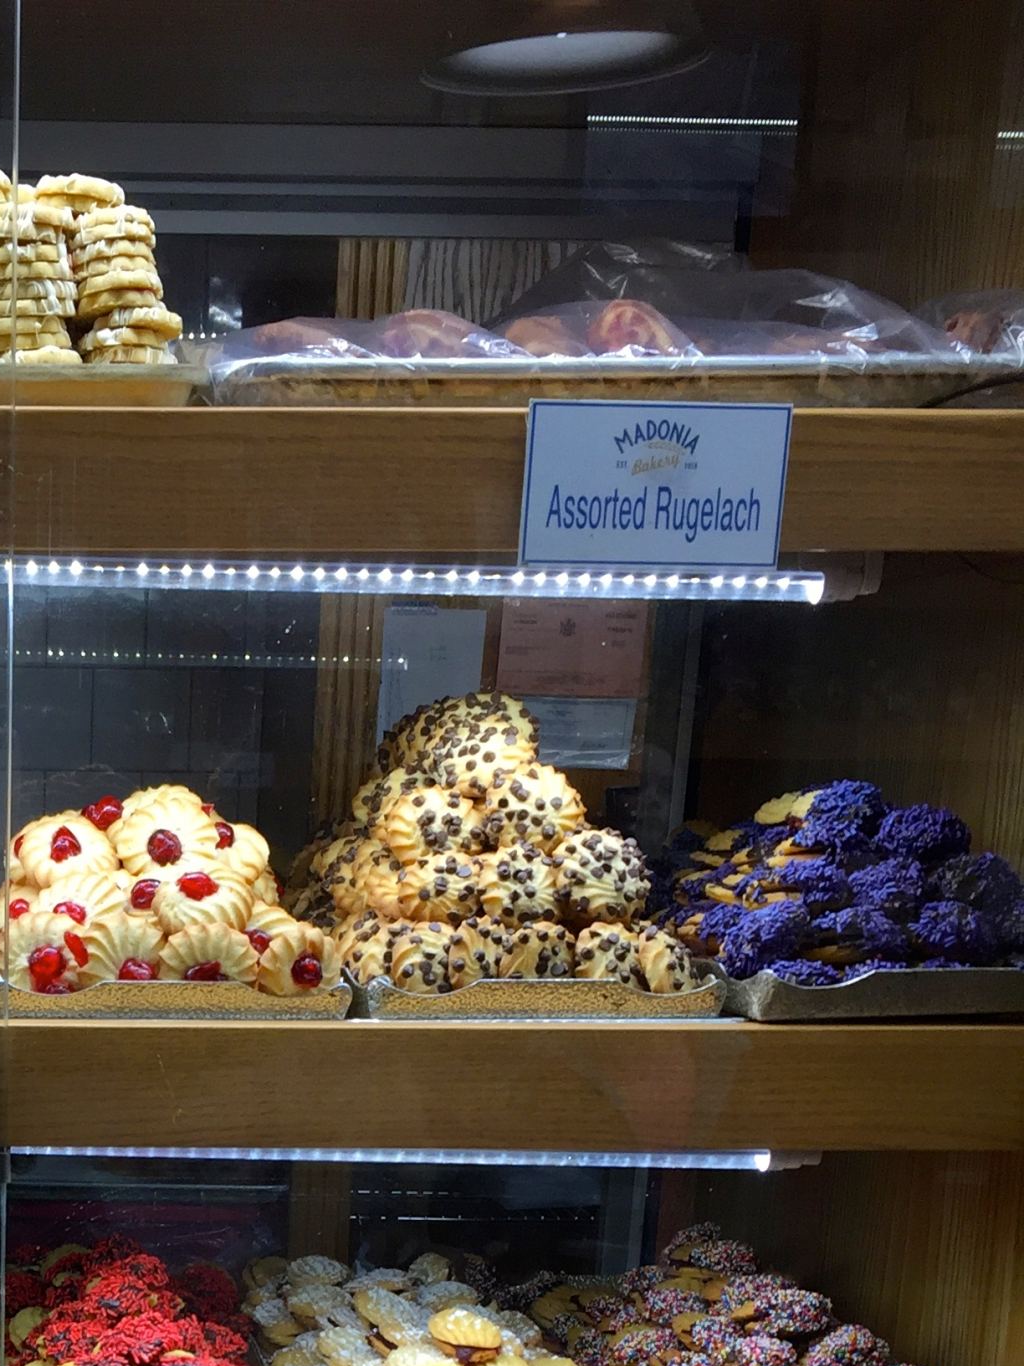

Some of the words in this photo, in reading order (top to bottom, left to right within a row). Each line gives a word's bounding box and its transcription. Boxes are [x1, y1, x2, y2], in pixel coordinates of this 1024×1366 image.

[614, 419, 700, 455] MADONIA
[631, 454, 682, 476] Bakery
[545, 484, 648, 530] Assorted
[655, 486, 761, 543] Rugelach
